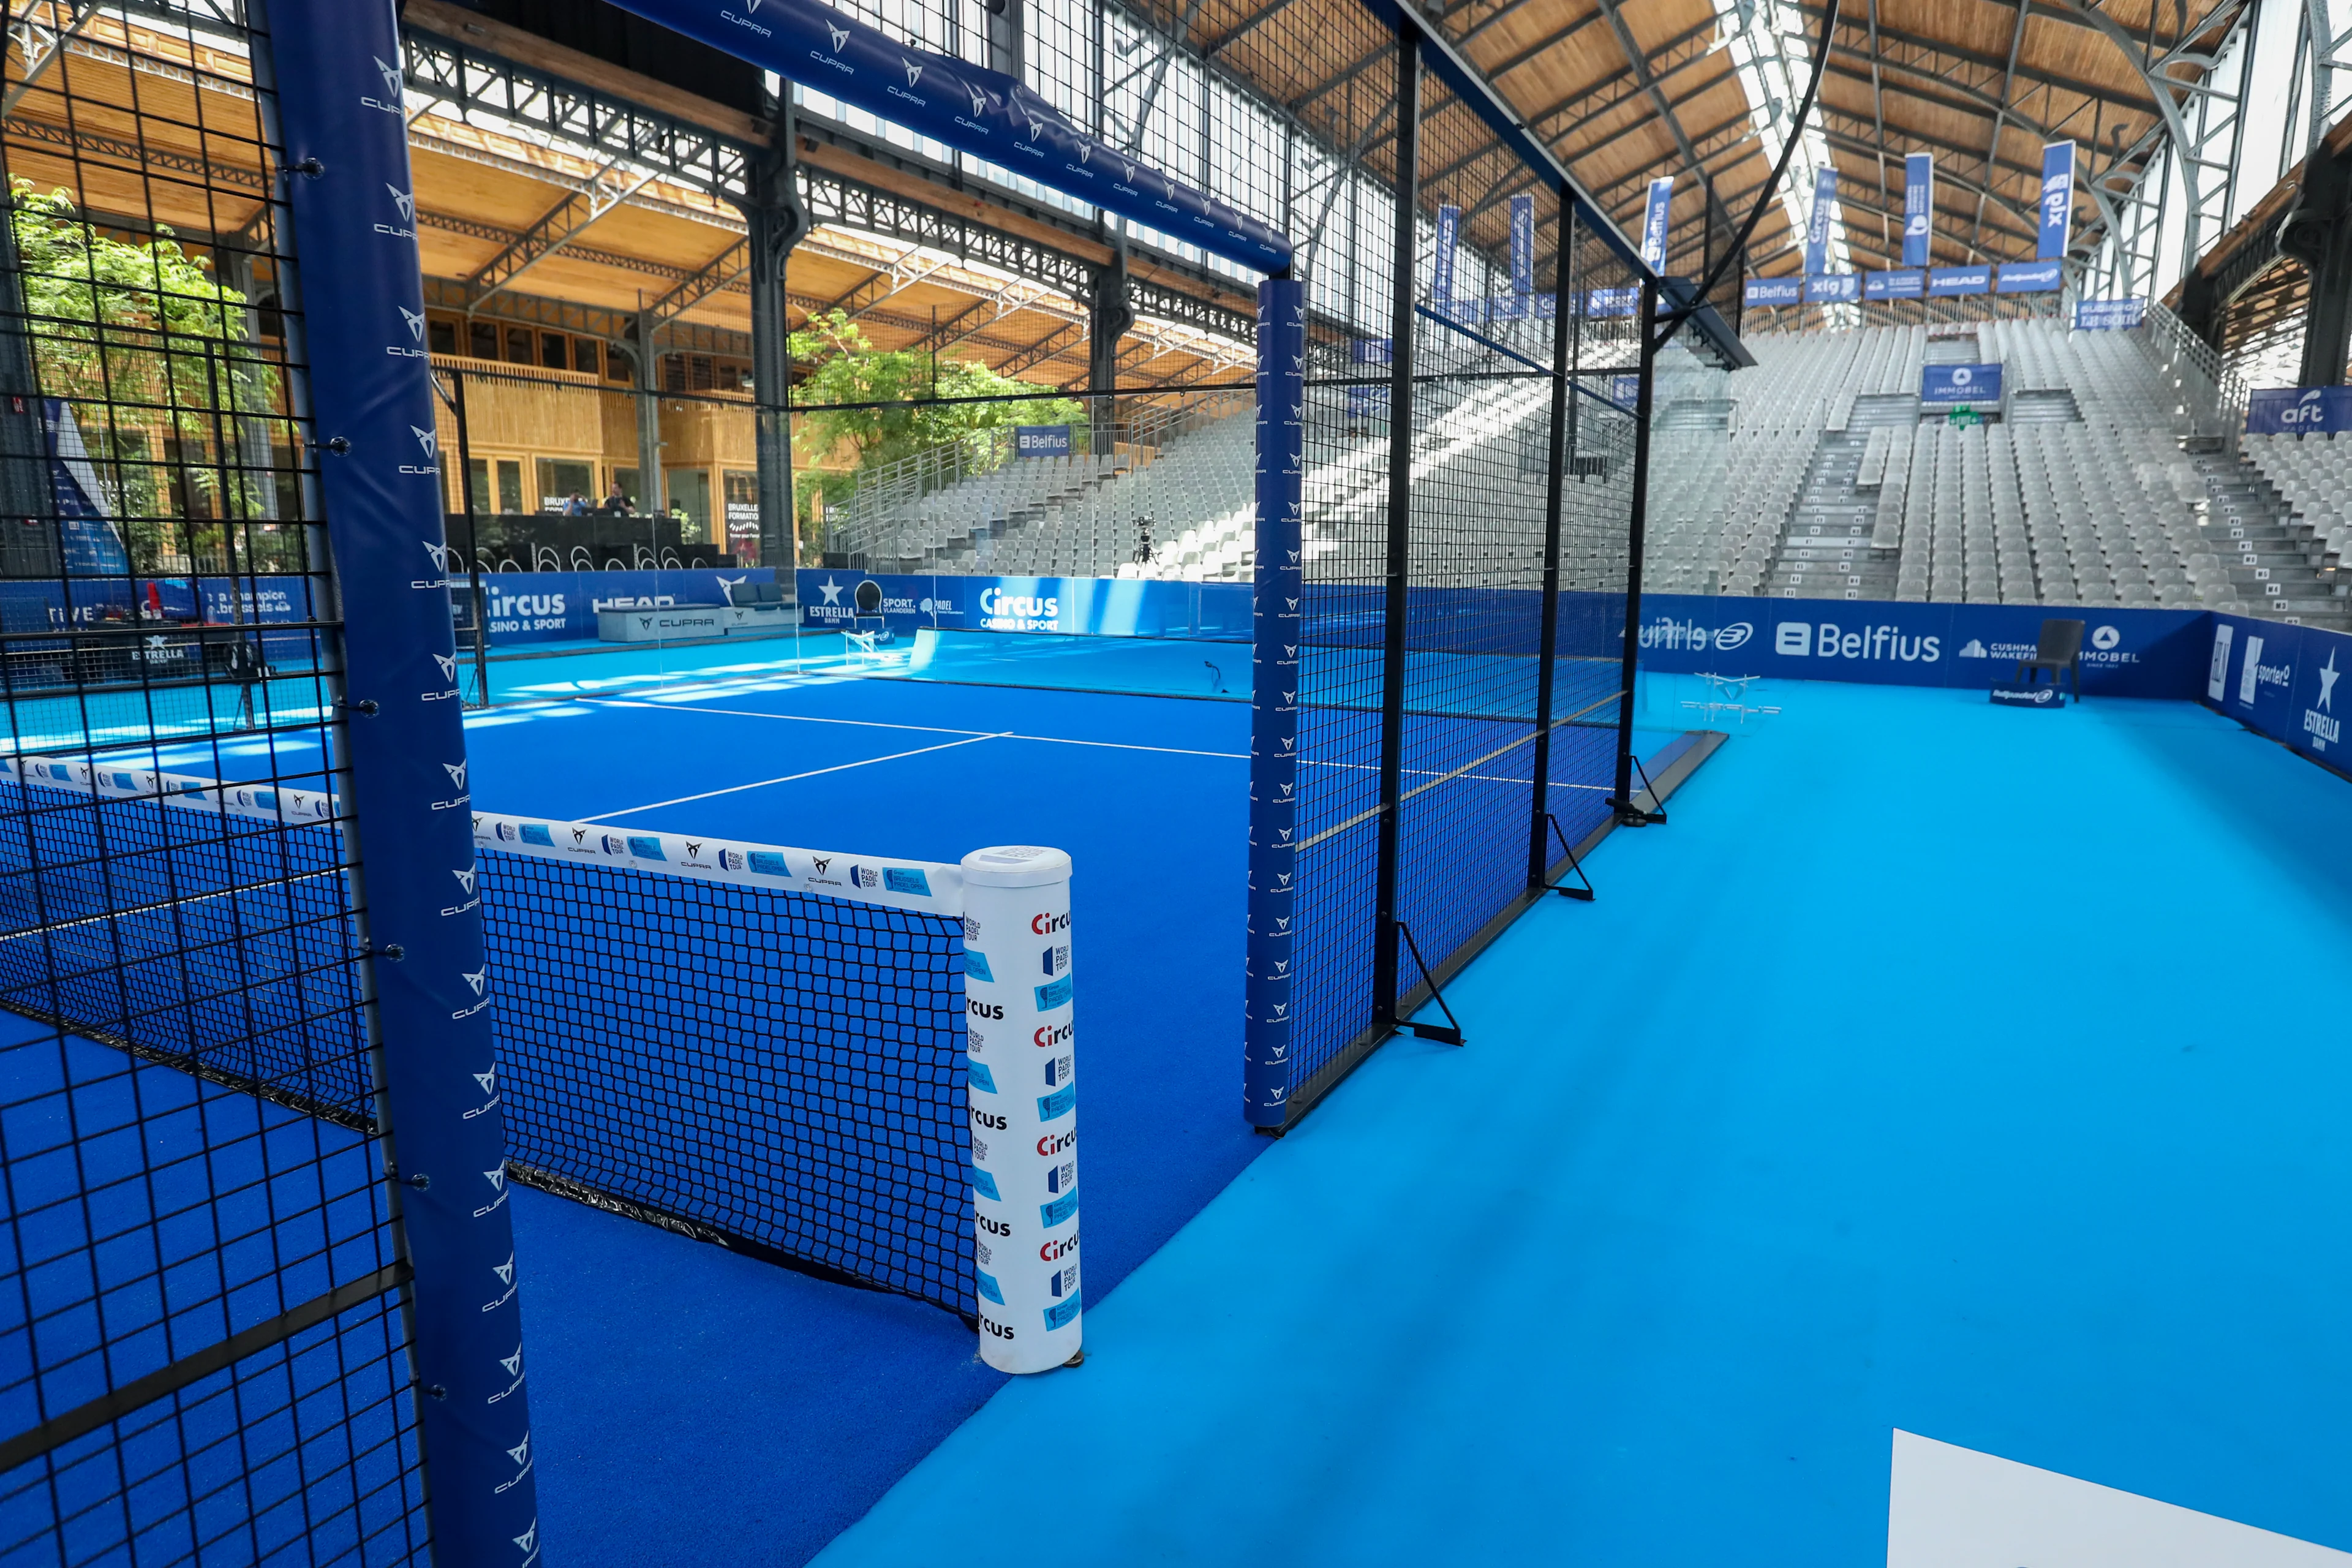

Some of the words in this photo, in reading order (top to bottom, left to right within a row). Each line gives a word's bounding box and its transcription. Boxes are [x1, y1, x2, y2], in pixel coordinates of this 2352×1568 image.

[720, 9, 772, 38] CUPRA
[810, 50, 854, 75] CUPRA
[887, 85, 926, 107] CUPRA
[954, 115, 989, 135] CUPRA
[1014, 141, 1044, 159] CUPRA
[1066, 163, 1094, 179] CUPRA
[1113, 183, 1138, 197] CUPRA
[1155, 200, 1178, 214] CUPRA
[1194, 216, 1215, 228] CUPRA
[1810, 198, 1825, 244] Circus
[1228, 230, 1247, 242] CUPRA
[1259, 243, 1276, 255] CUPRA
[1812, 280, 1840, 295] xlg
[1932, 275, 1986, 287] HEAD
[1760, 285, 1797, 298] Belfius
[1934, 386, 1986, 395] IMMOBEL
[2281, 404, 2324, 423] aft
[1031, 435, 1067, 448] Belfius
[486, 586, 565, 617] ircus
[883, 598, 916, 608] SPORT.
[934, 600, 952, 610] PADEL
[980, 587, 1058, 617] Circus
[810, 606, 854, 618] ESTRELLA
[522, 620, 531, 631] &
[534, 617, 566, 630] SPORT
[659, 618, 714, 627] CUPRA
[980, 618, 1016, 630] CASINO
[1017, 619, 1025, 630] &
[1027, 619, 1058, 631] SPORT
[1818, 623, 1940, 663] Belfius
[1991, 643, 2037, 652] CUSHMA
[1991, 652, 2037, 660] WAKEFI
[2258, 665, 2290, 687] sportero
[2304, 709, 2340, 743] ESTRELLA
[2312, 736, 2326, 752] DAMM
[728, 851, 742, 860] WORLD
[680, 861, 712, 870] CUPRA
[861, 867, 878, 876] WORLD
[808, 876, 842, 886] CUPRA
[965, 916, 981, 929] WORLD
[1031, 911, 1071, 935] Circu
[966, 924, 979, 935] PADEL
[966, 932, 978, 941] TOUR
[1055, 945, 1069, 955] WORLD
[1056, 952, 1068, 963] PADEL
[1056, 960, 1068, 971] TOUR
[967, 997, 1004, 1020] rcus
[969, 1027, 984, 1041] WORLD
[1034, 1022, 1074, 1048] Circu
[969, 1036, 983, 1047] PADEL
[970, 1044, 981, 1053] TOUR
[1058, 1055, 1071, 1066] WORLD
[1058, 1062, 1071, 1074] PADEL
[1058, 1070, 1070, 1082] TOUR
[971, 1106, 1007, 1130] rcus
[973, 1135, 988, 1150] WORLD
[1037, 1129, 1077, 1156] Circu
[974, 1143, 987, 1156] PADEL
[974, 1150, 985, 1161] TOUR
[1060, 1160, 1074, 1173] WORLD
[1061, 1168, 1074, 1180] PADEL
[1061, 1175, 1072, 1188] TOUR
[976, 1210, 1011, 1237] rcus
[1040, 1231, 1079, 1261] Circu
[1064, 1263, 1077, 1276] WORLD
[1064, 1272, 1077, 1284] PADEL
[1065, 1278, 1076, 1292] TOUR
[980, 1312, 1014, 1340] rcus
